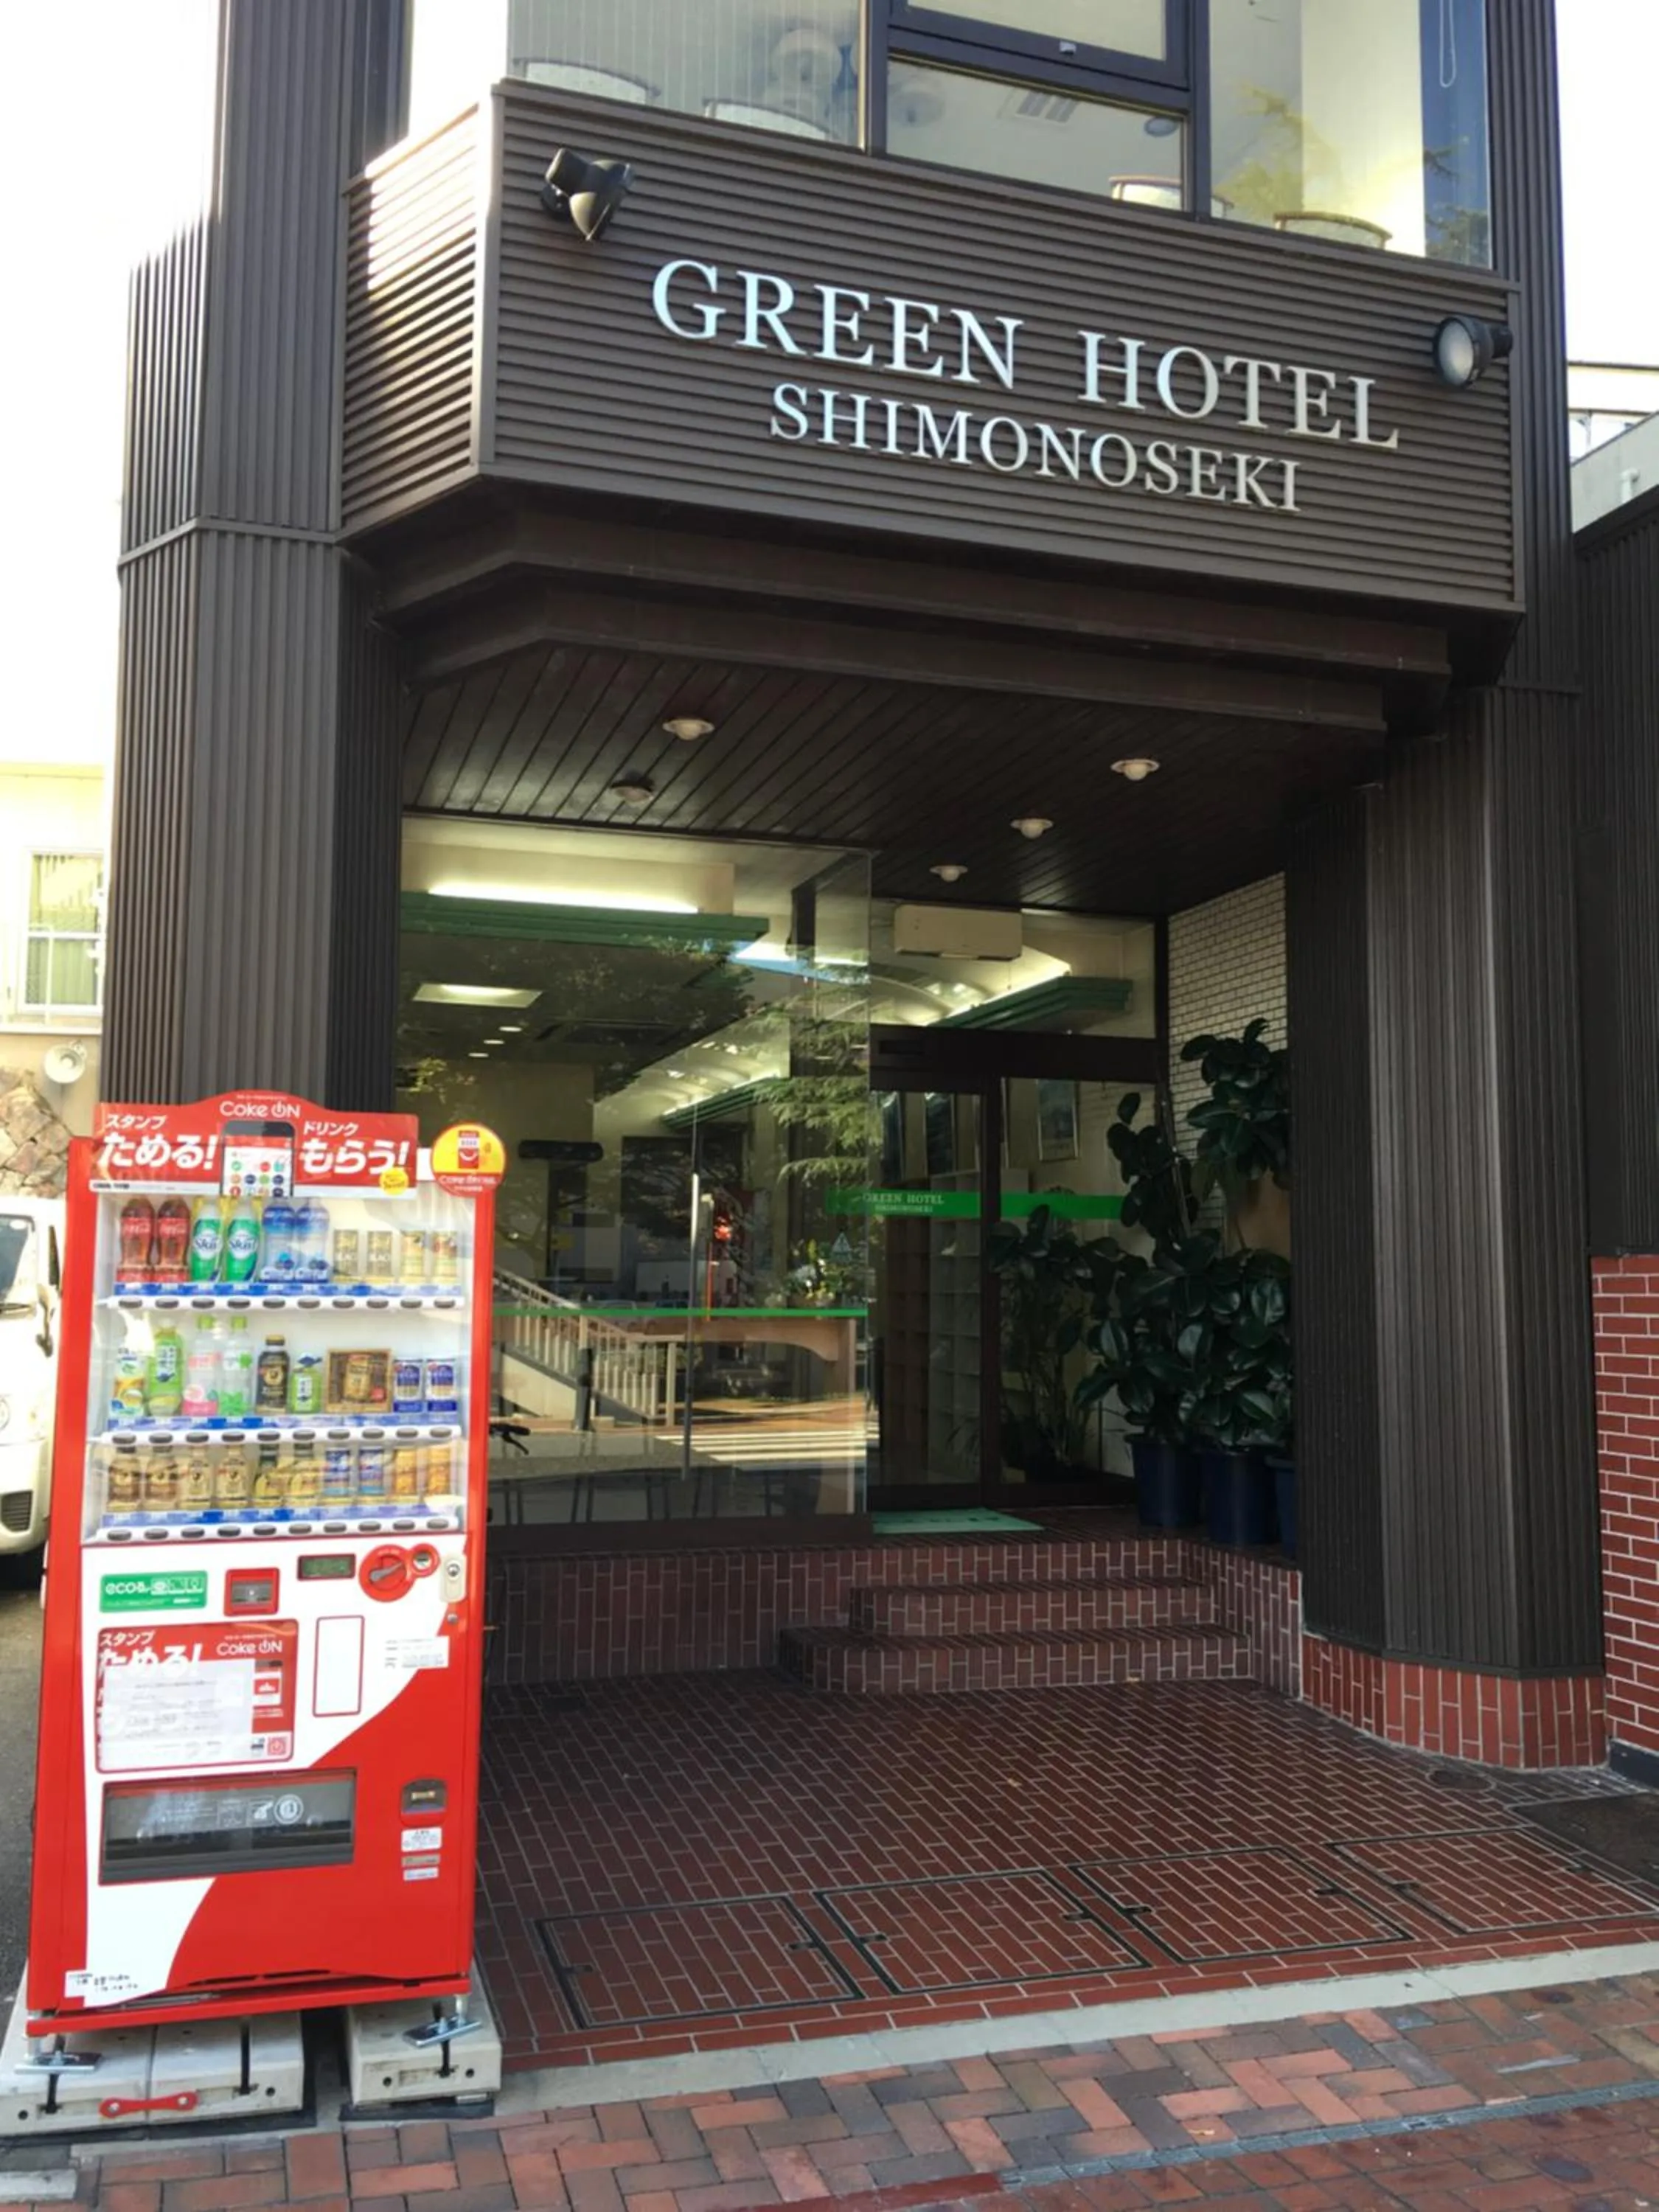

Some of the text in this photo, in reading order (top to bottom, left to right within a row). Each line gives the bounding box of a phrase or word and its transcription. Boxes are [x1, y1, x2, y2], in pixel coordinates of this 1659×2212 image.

[652, 258, 1399, 450] GREEN HOTEL
[771, 382, 1301, 513] SHIMONOSEKI
[219, 1101, 268, 1117] Coke
[105, 1113, 168, 1130] スタンプ
[303, 1120, 359, 1136] ドリンク
[100, 1630, 155, 1646] スタンプ
[216, 1641, 257, 1656] Coke
